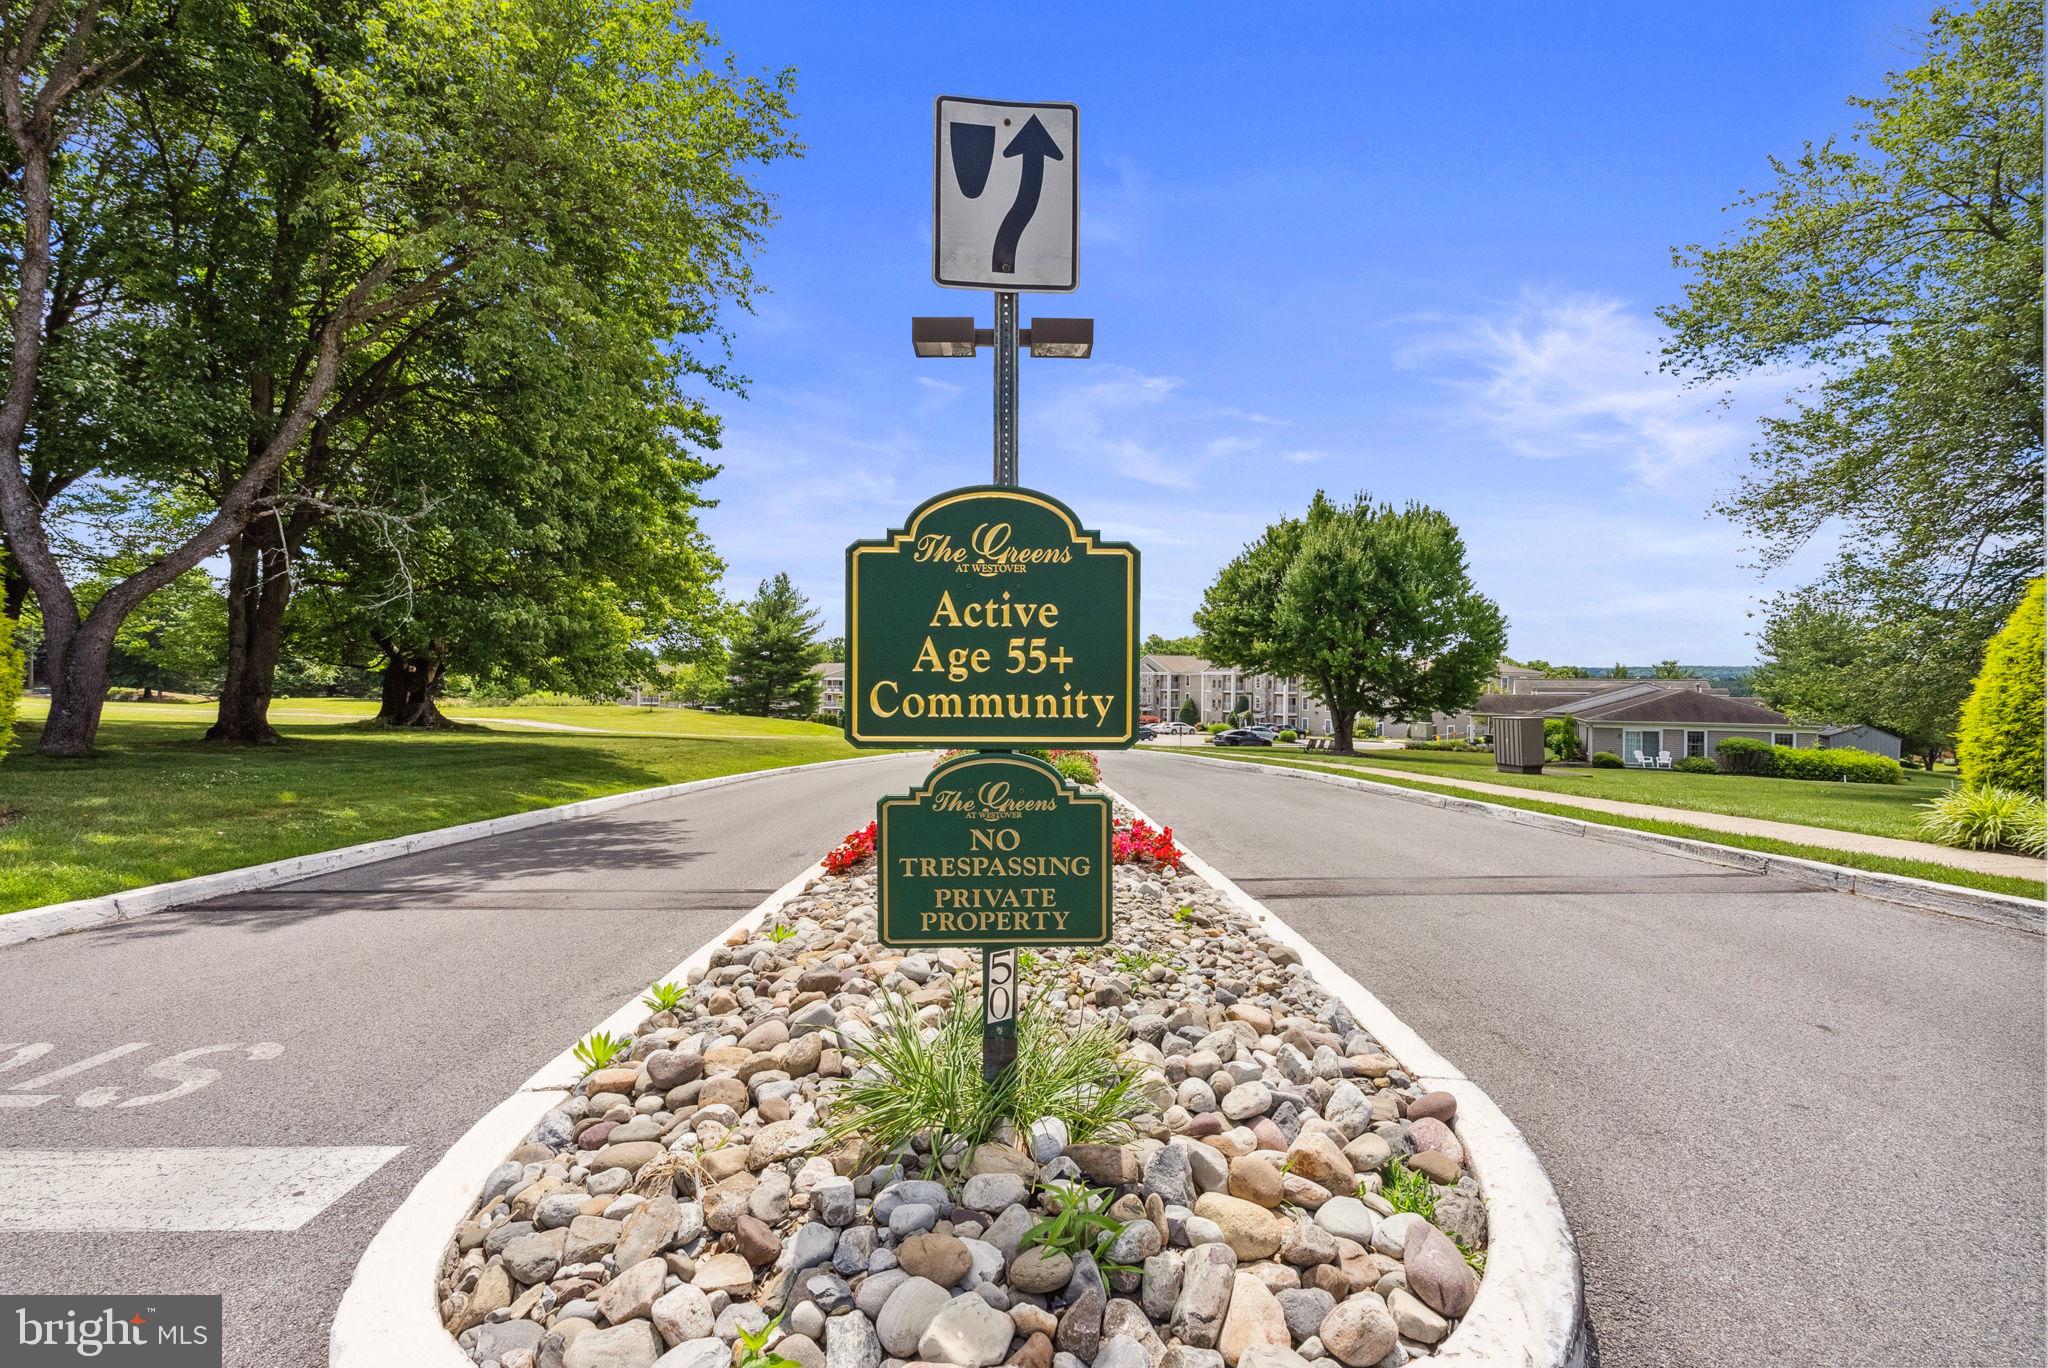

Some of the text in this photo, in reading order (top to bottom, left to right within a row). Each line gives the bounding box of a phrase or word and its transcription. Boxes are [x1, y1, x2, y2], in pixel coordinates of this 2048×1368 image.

[913, 523, 1073, 570] The Greens
[955, 563, 1027, 574] AT WESTOVER
[929, 590, 1059, 628] Active
[912, 635, 1074, 682] Age 55+
[869, 680, 1115, 728] Community
[932, 781, 1057, 815] The Greens
[969, 828, 1021, 851] NO
[899, 857, 1091, 877] TRESPASSING
[934, 888, 1056, 909] PRIVATE
[920, 911, 1071, 932] PROPERTY
